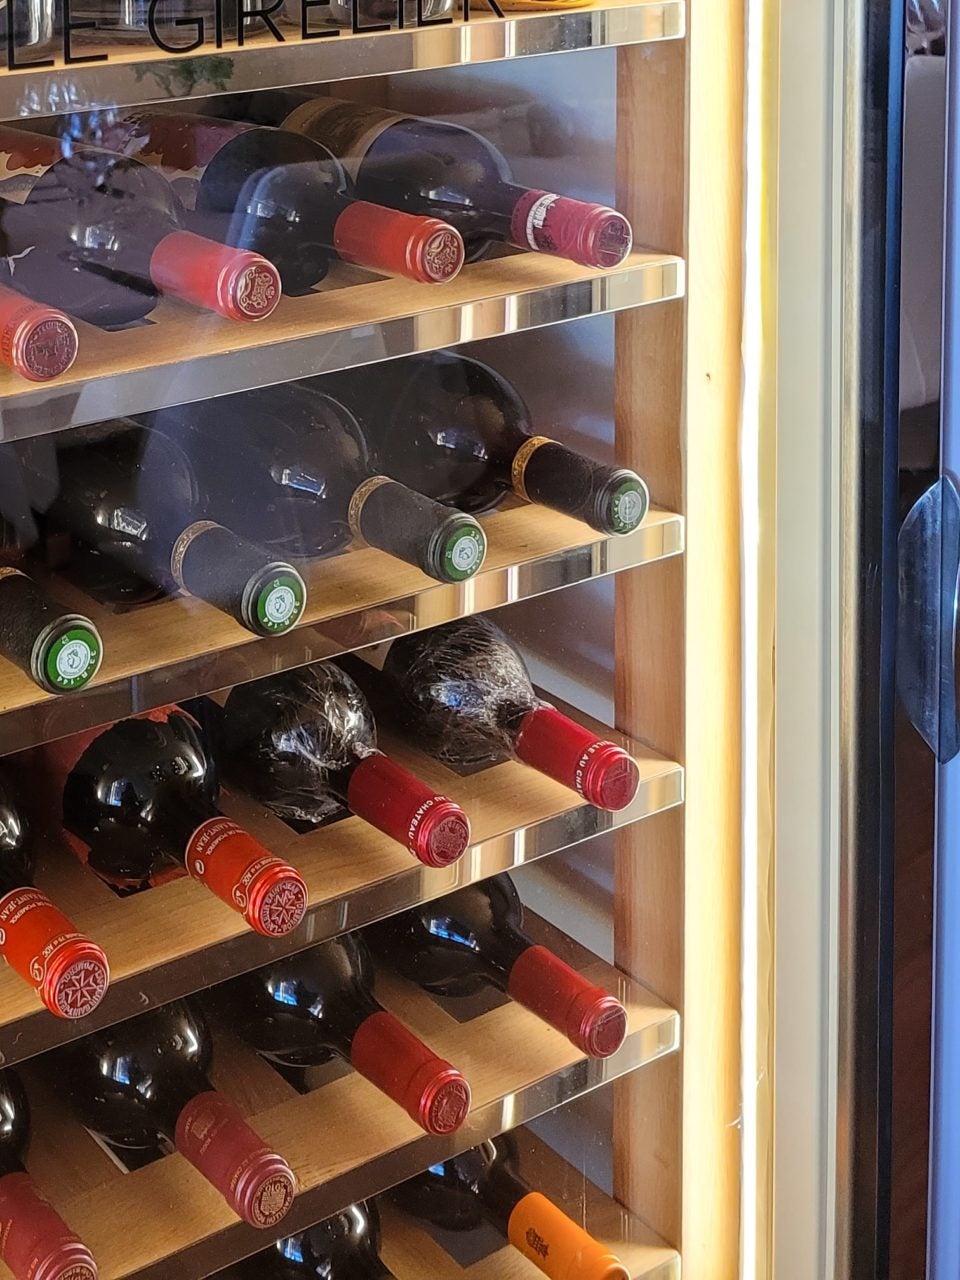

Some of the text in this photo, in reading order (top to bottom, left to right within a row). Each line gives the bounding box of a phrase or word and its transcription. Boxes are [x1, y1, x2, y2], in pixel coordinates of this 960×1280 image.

[578, 753, 590, 768] AU
[407, 799, 434, 840] CHATEAU
[205, 832, 228, 856] POMEROL
[242, 872, 252, 886] AOC
[0, 892, 38, 922] SAINT-JEAN
[9, 901, 37, 926] POMEROL
[41, 943, 55, 959] AOC
[62, 961, 95, 983] POMEROL
